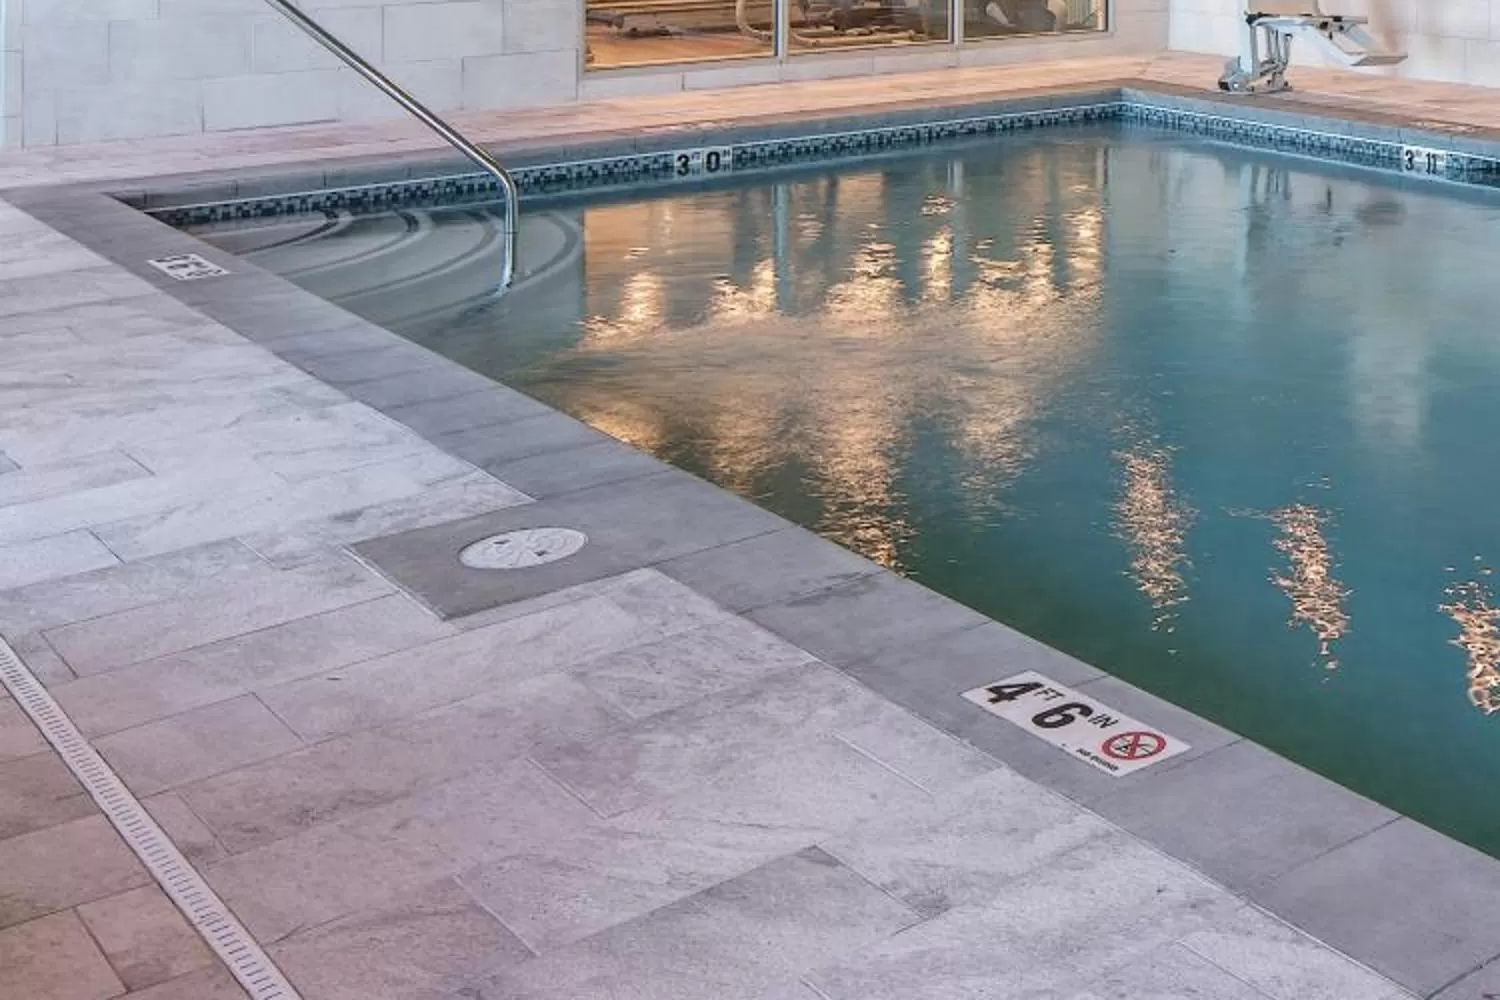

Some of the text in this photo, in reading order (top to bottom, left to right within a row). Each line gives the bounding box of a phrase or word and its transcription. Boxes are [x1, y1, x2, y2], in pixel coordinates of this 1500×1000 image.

[985, 681, 1120, 729] 4 FT 6 IN
